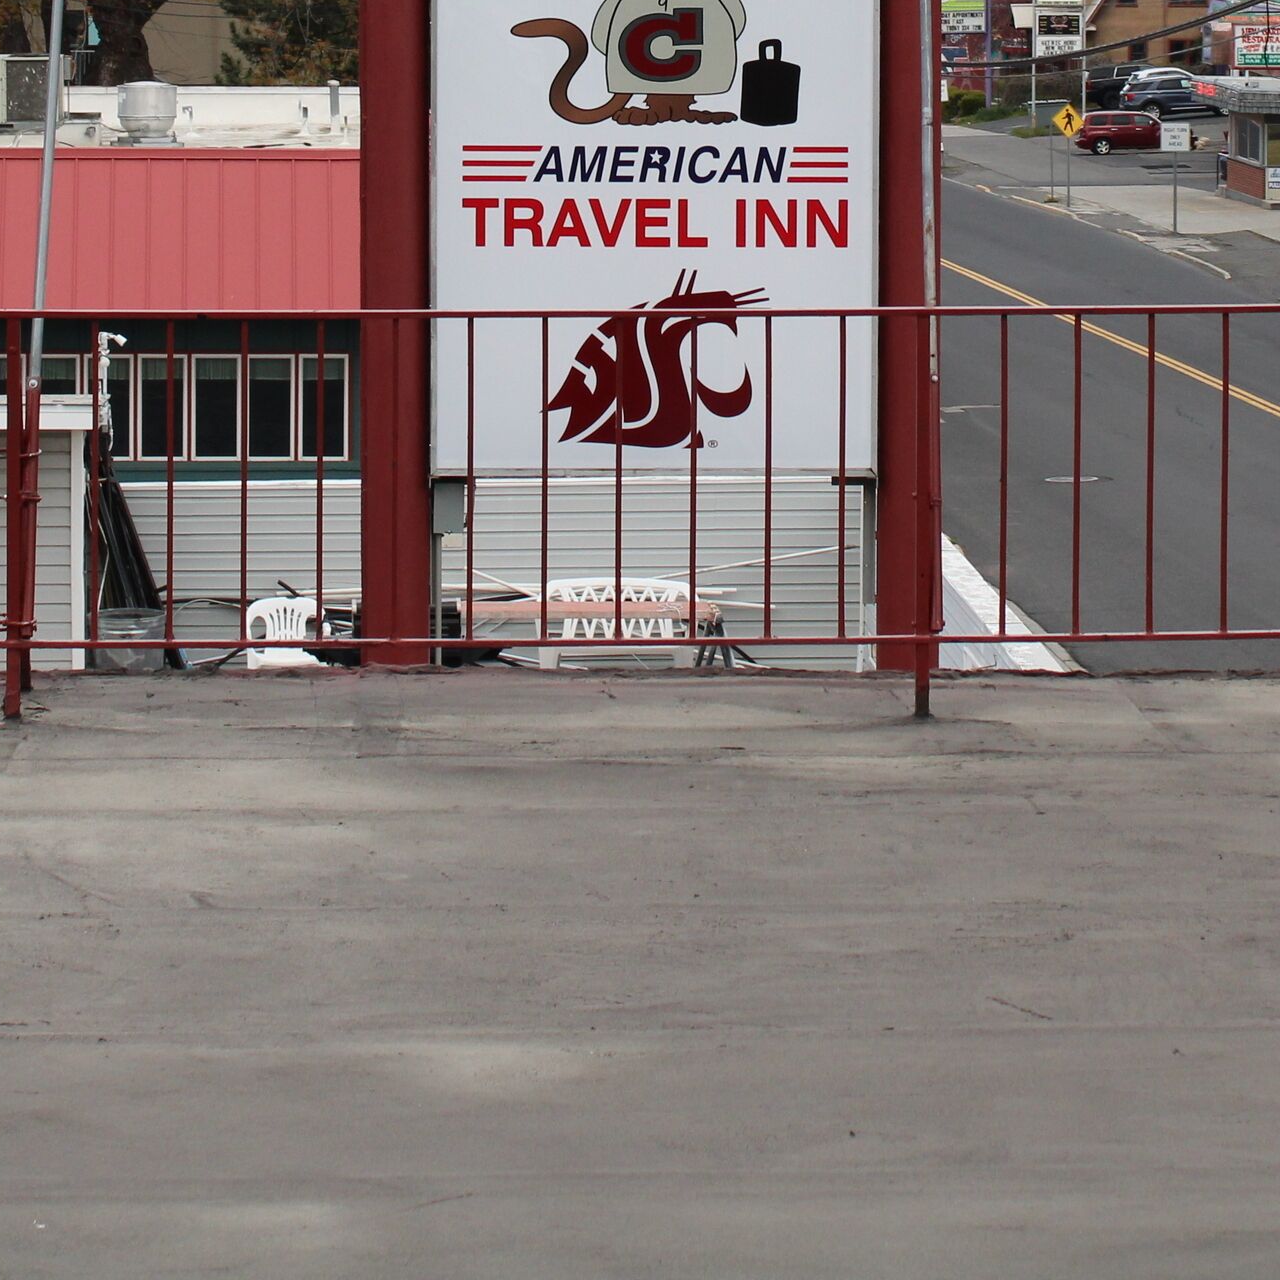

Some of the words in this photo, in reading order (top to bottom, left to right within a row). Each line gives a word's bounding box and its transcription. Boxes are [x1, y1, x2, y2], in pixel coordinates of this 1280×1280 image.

[618, 7, 704, 83] C
[533, 145, 787, 183] AMERICAN
[462, 197, 709, 248] TRAVEL
[735, 198, 849, 248] INN
